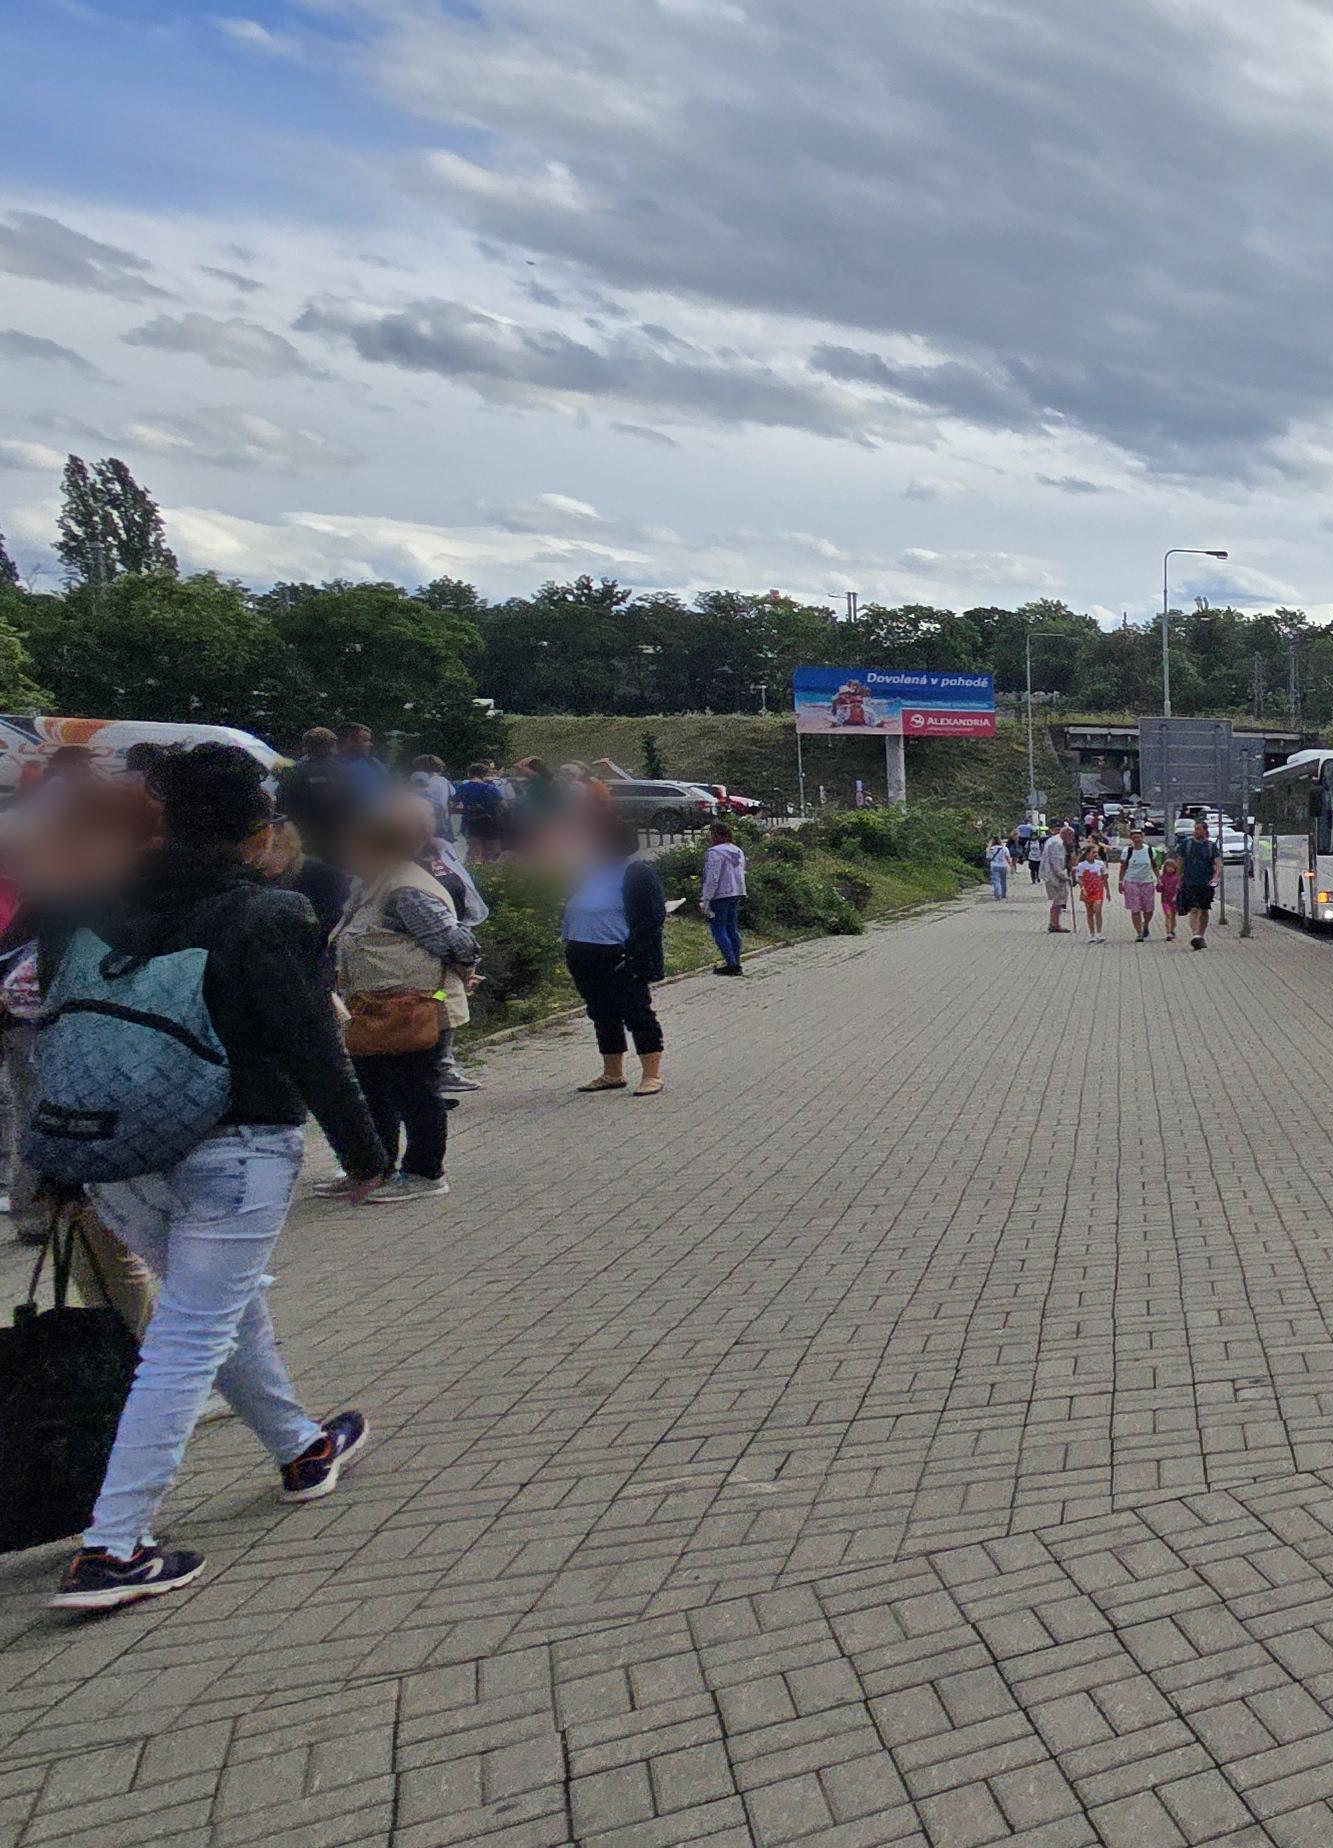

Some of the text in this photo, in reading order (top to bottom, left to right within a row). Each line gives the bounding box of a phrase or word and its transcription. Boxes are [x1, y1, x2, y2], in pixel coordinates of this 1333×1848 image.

[867, 673, 927, 685] Dovolená
[930, 677, 938, 685] v
[926, 716, 991, 727] ALEXANDRIA
